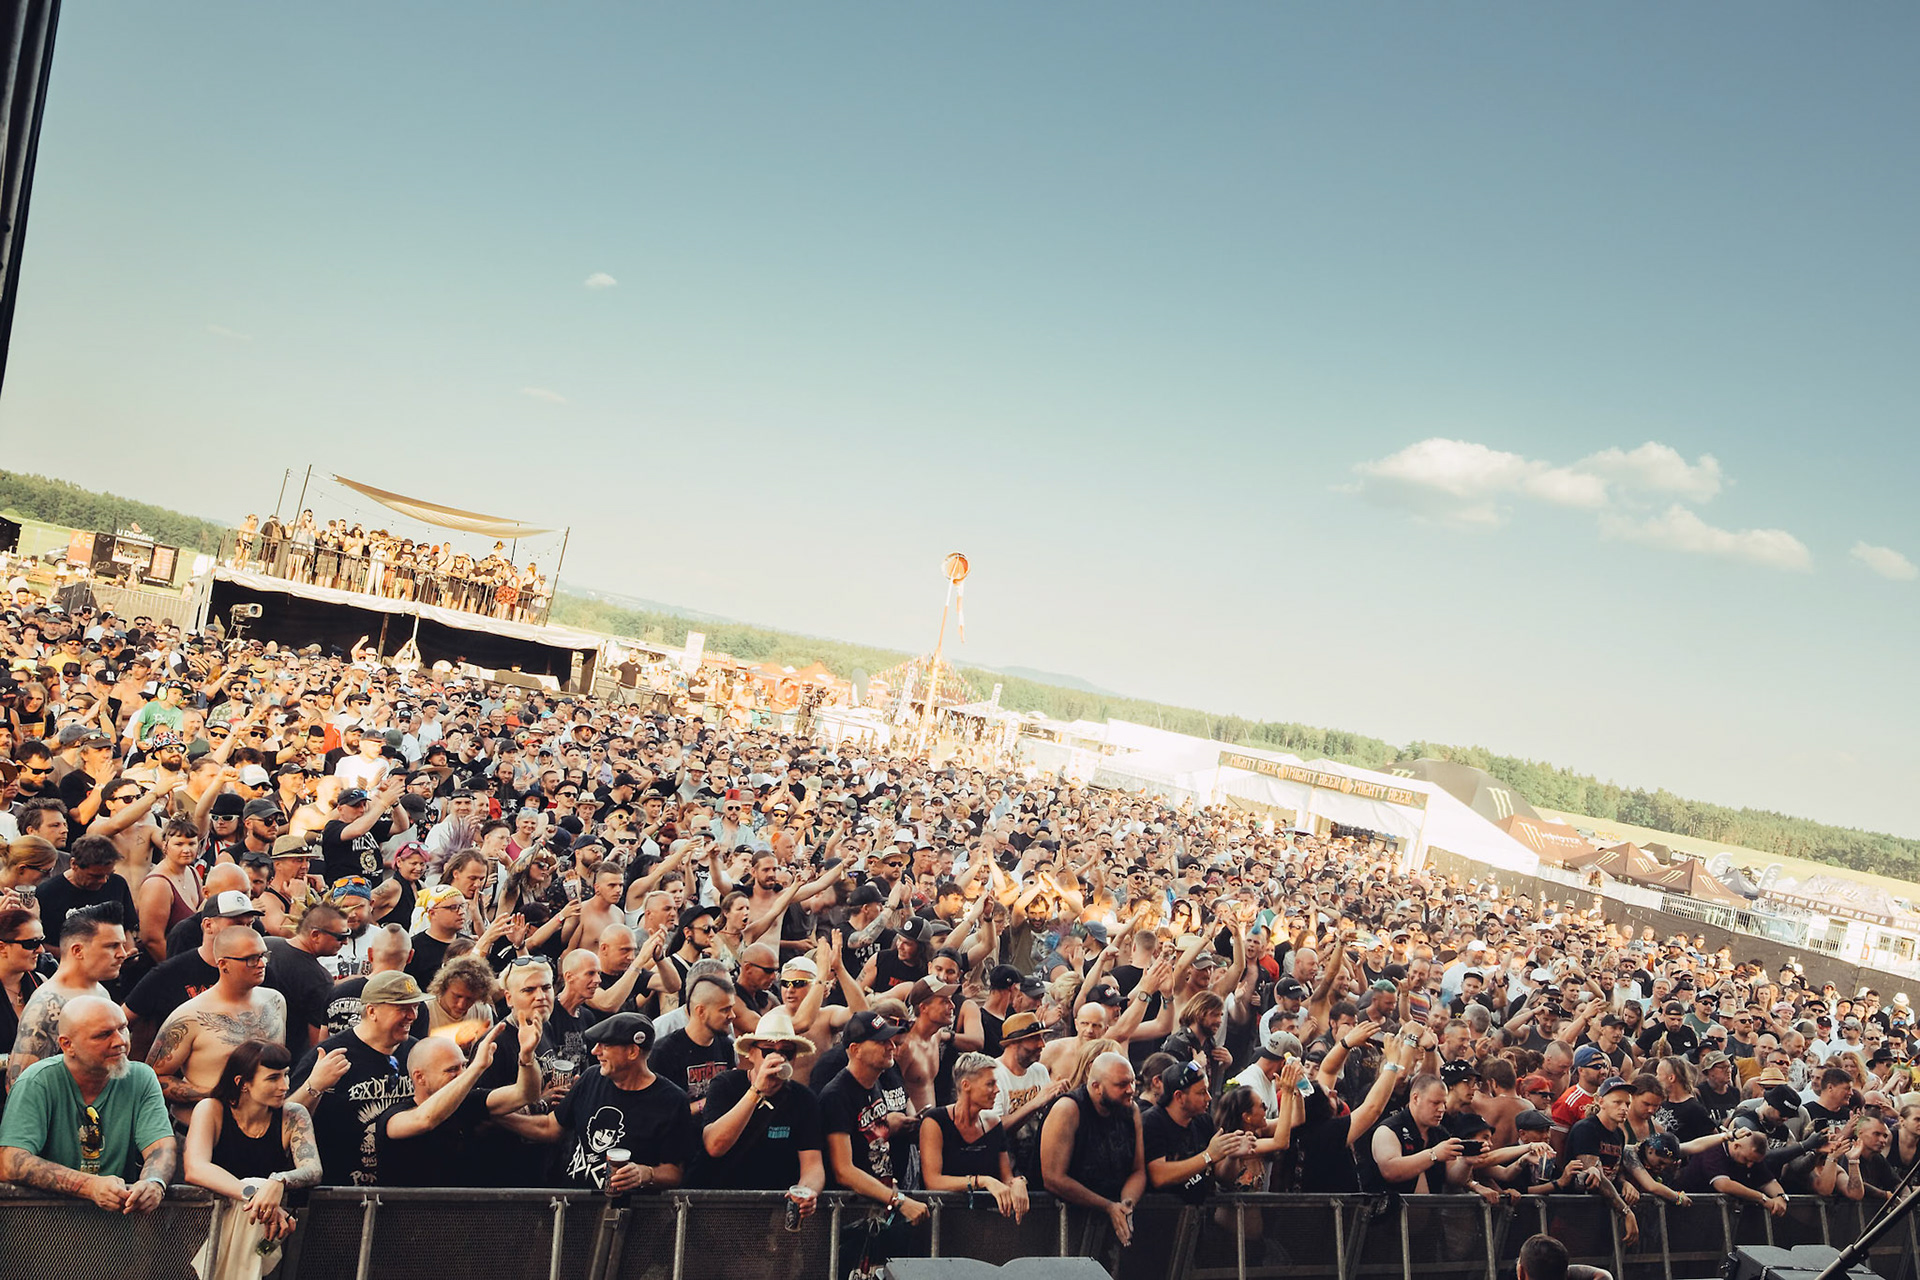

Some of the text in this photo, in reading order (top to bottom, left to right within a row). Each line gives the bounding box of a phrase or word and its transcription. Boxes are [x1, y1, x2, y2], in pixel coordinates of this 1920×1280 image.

[1230, 754, 1411, 805] MIGHTY BEER MIGHTY BEER MIGHTY BEER
[348, 1074, 415, 1101] EXPLITE
[566, 1135, 608, 1189] ADIC
[585, 1153, 601, 1163] THE
[1184, 1173, 1203, 1189] FILA
